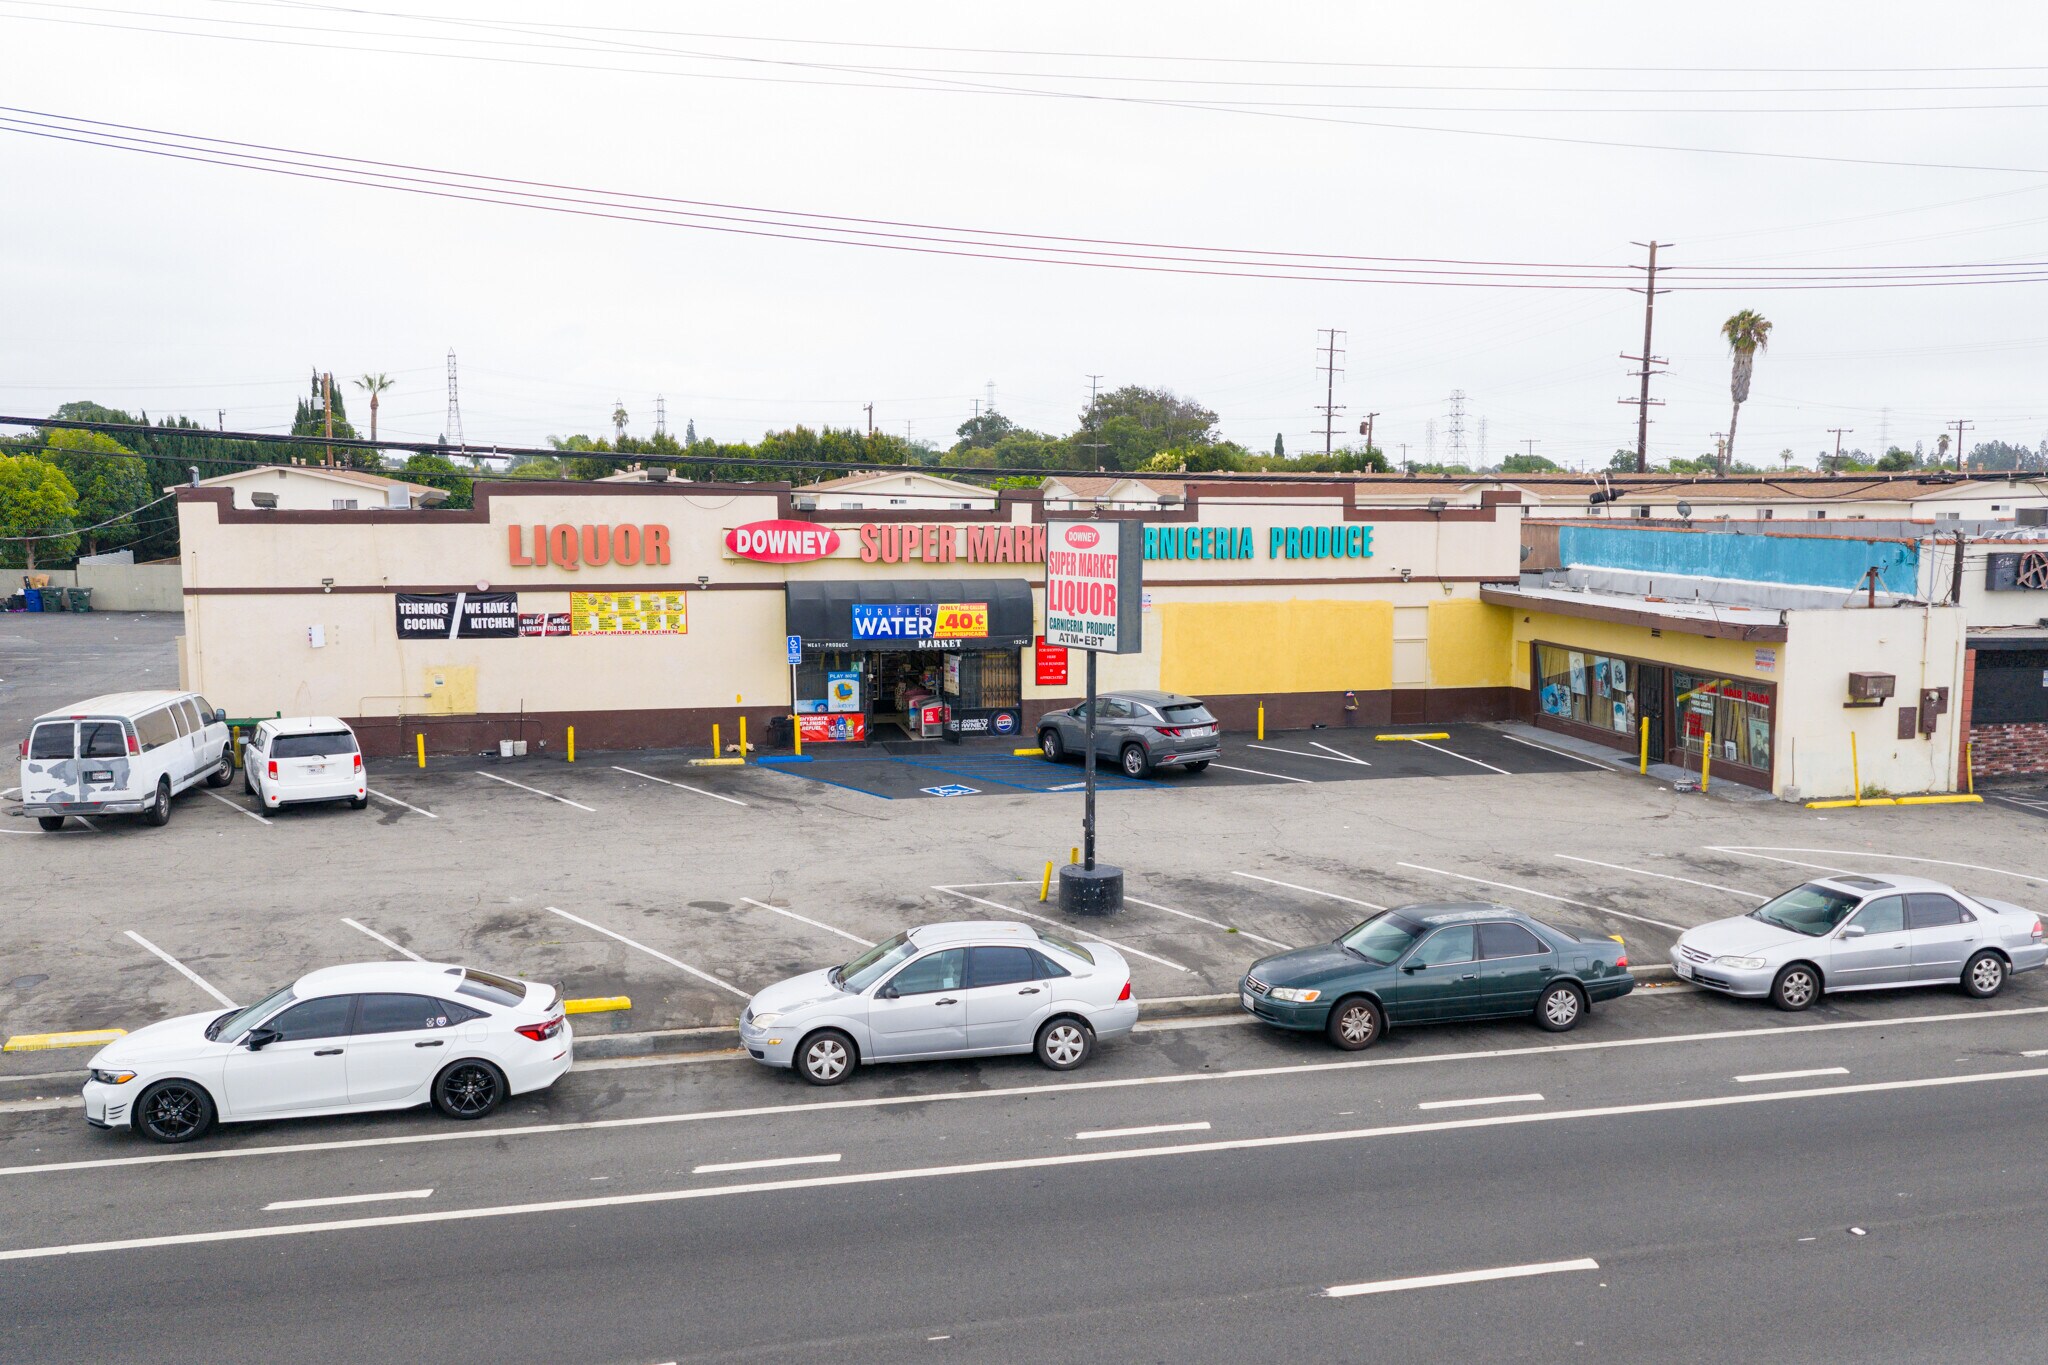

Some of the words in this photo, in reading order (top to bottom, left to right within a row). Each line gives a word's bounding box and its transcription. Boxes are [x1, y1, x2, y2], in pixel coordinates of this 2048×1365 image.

[736, 529, 831, 555] DOWNEY
[860, 523, 958, 563] SUPER
[966, 525, 1046, 563] MARK
[1068, 531, 1097, 542] DOWNEY
[1143, 526, 1254, 560] RNICERIA
[1270, 525, 1374, 559] PRODUCE
[508, 523, 671, 571] LIQUOR
[1049, 551, 1076, 576] SUPER
[1079, 553, 1118, 579] MARKET
[1049, 579, 1117, 617] LIQUOR
[399, 602, 449, 615] TENEMOS
[464, 602, 481, 614] WE
[483, 602, 508, 614] HAVE
[510, 602, 518, 613] A
[855, 607, 932, 616] PURIFIED
[403, 618, 446, 630] COCINA
[470, 617, 515, 629] KITCHEN
[855, 617, 932, 636] WATER
[1049, 617, 1083, 633] CARNICERIA
[1086, 621, 1115, 637] PRODUCE
[918, 639, 962, 648] MARKET
[1058, 633, 1105, 647] ATM-EBT
[1724, 687, 1742, 698] HAIR
[1747, 691, 1770, 704] SALON
